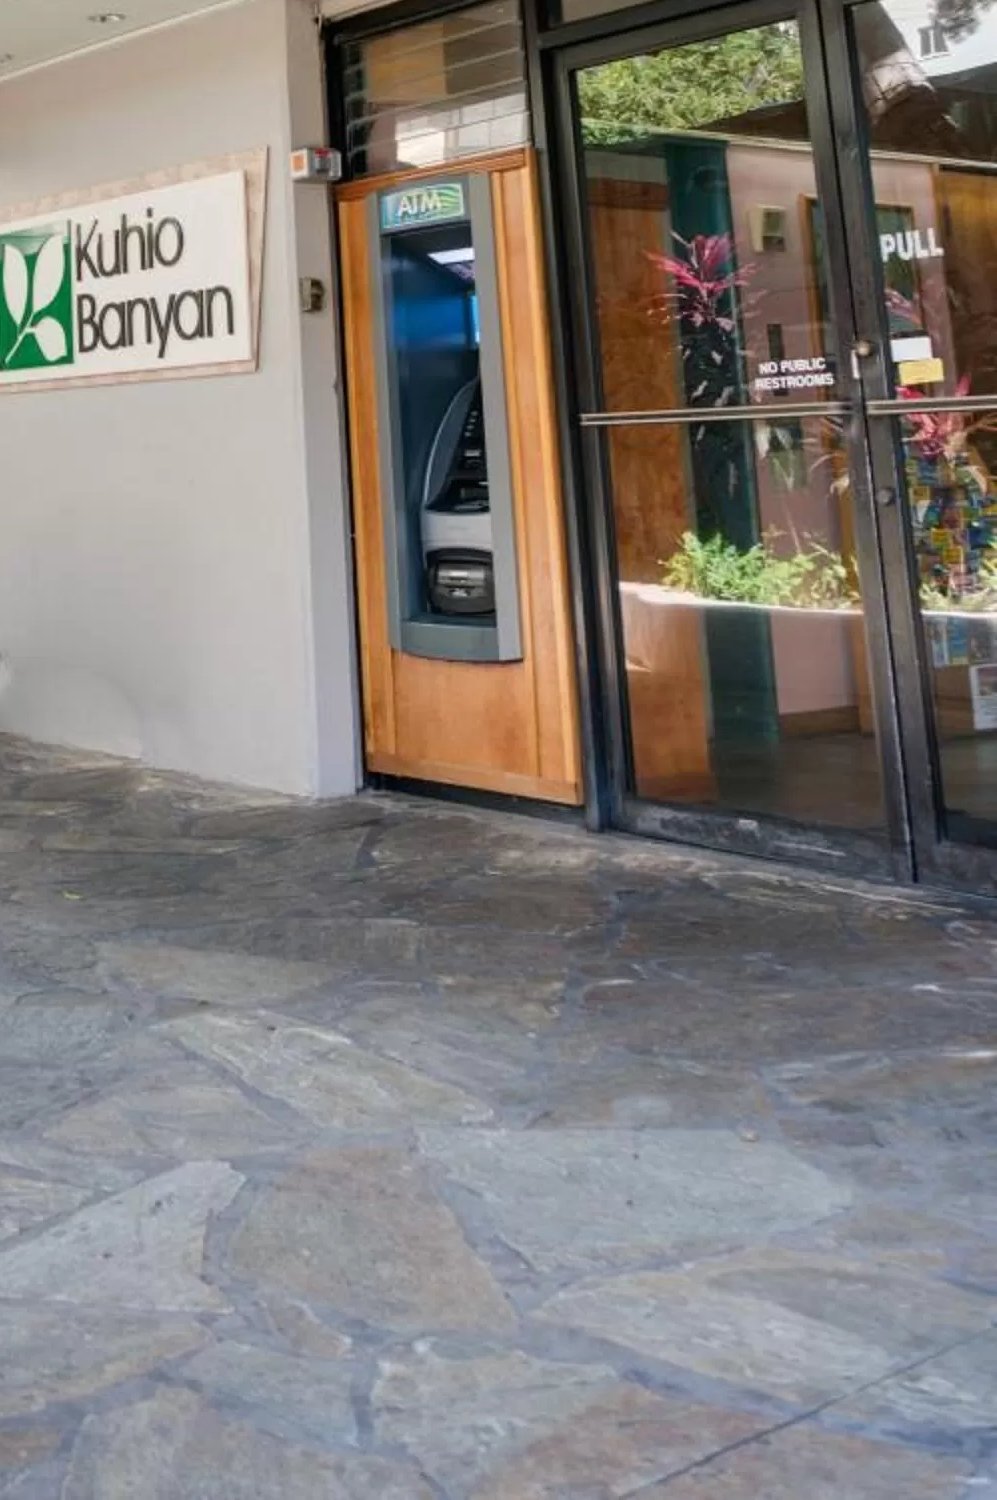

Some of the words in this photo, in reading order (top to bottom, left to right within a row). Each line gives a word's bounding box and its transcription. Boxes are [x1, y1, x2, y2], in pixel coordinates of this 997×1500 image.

[398, 189, 443, 217] ATM
[76, 207, 184, 282] Kuhio
[879, 227, 945, 263] PULL
[76, 285, 234, 359] Banyan
[755, 372, 834, 391] RESTROOMS
[759, 361, 778, 374] NO
[780, 357, 826, 373] PUBLIC
